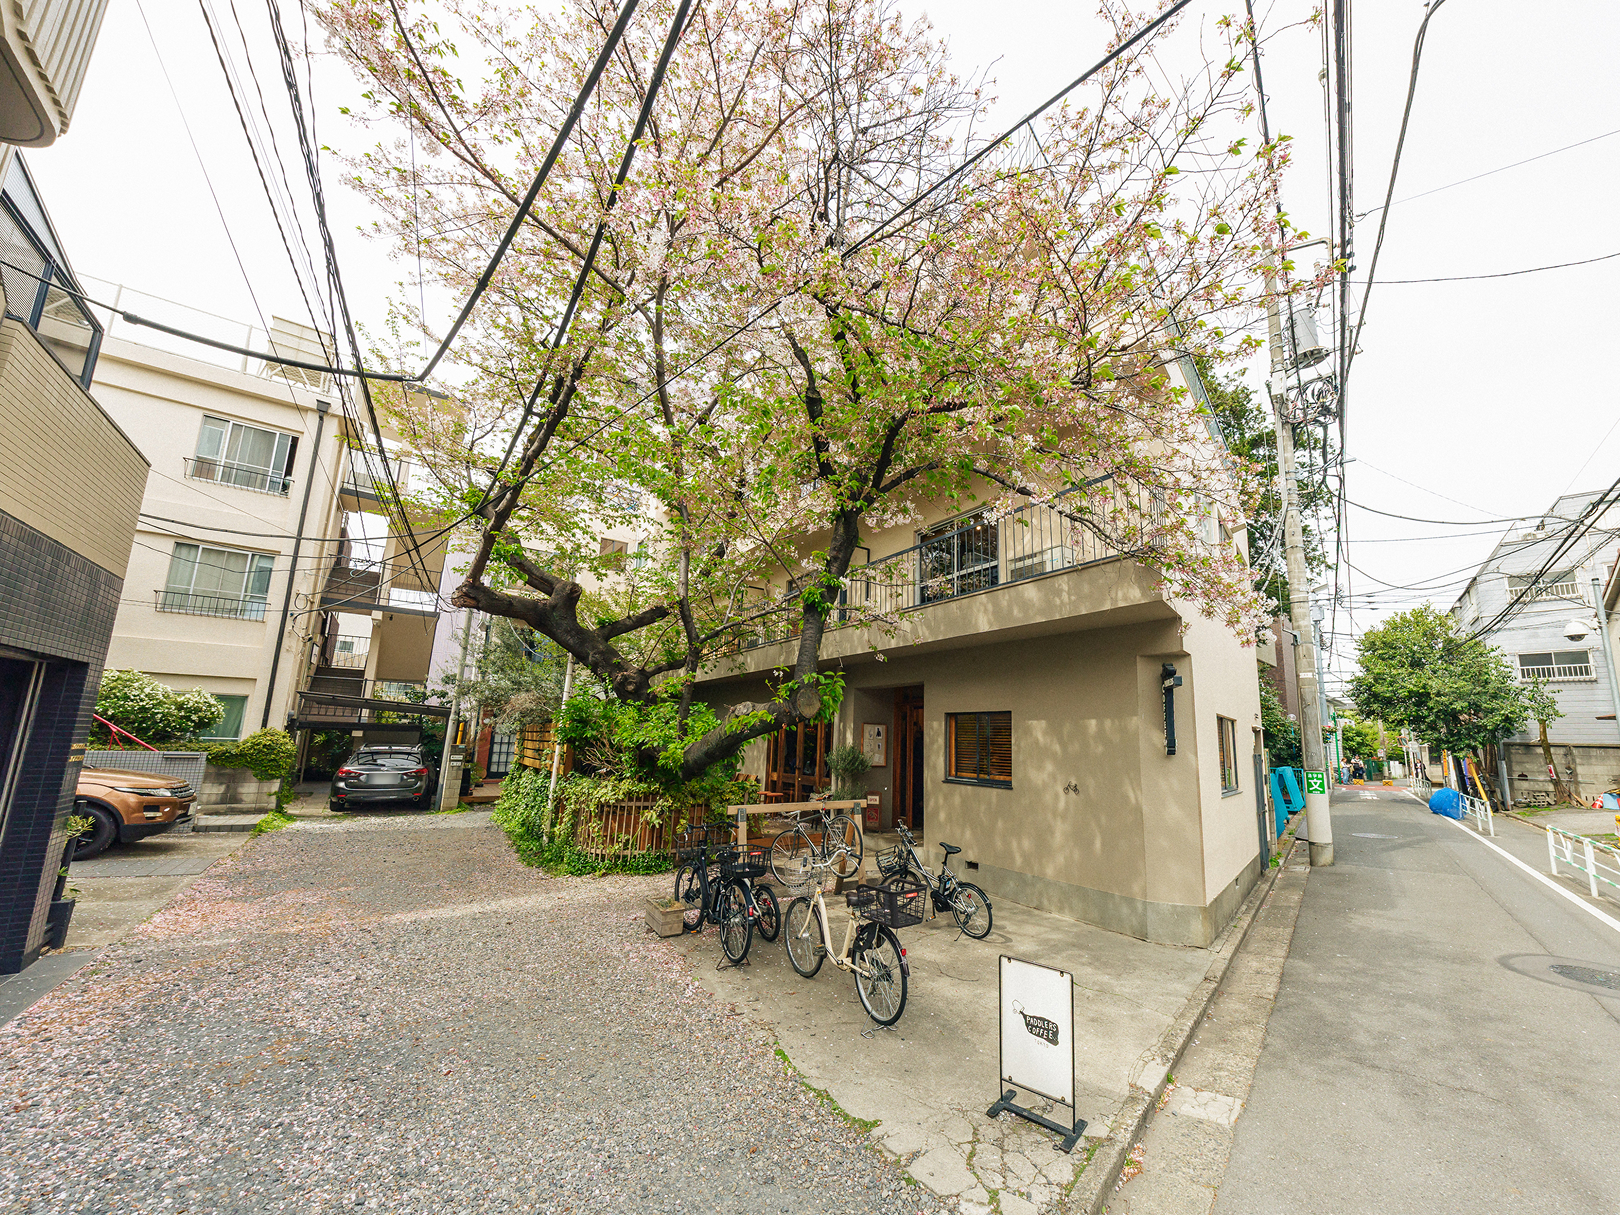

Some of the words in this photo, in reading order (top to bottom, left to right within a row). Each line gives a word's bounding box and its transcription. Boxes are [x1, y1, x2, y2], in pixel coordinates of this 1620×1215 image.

[1308, 778, 1323, 791] 文
[1026, 1015, 1057, 1032] PADDLERS
[1028, 1025, 1053, 1040] COFFEE
